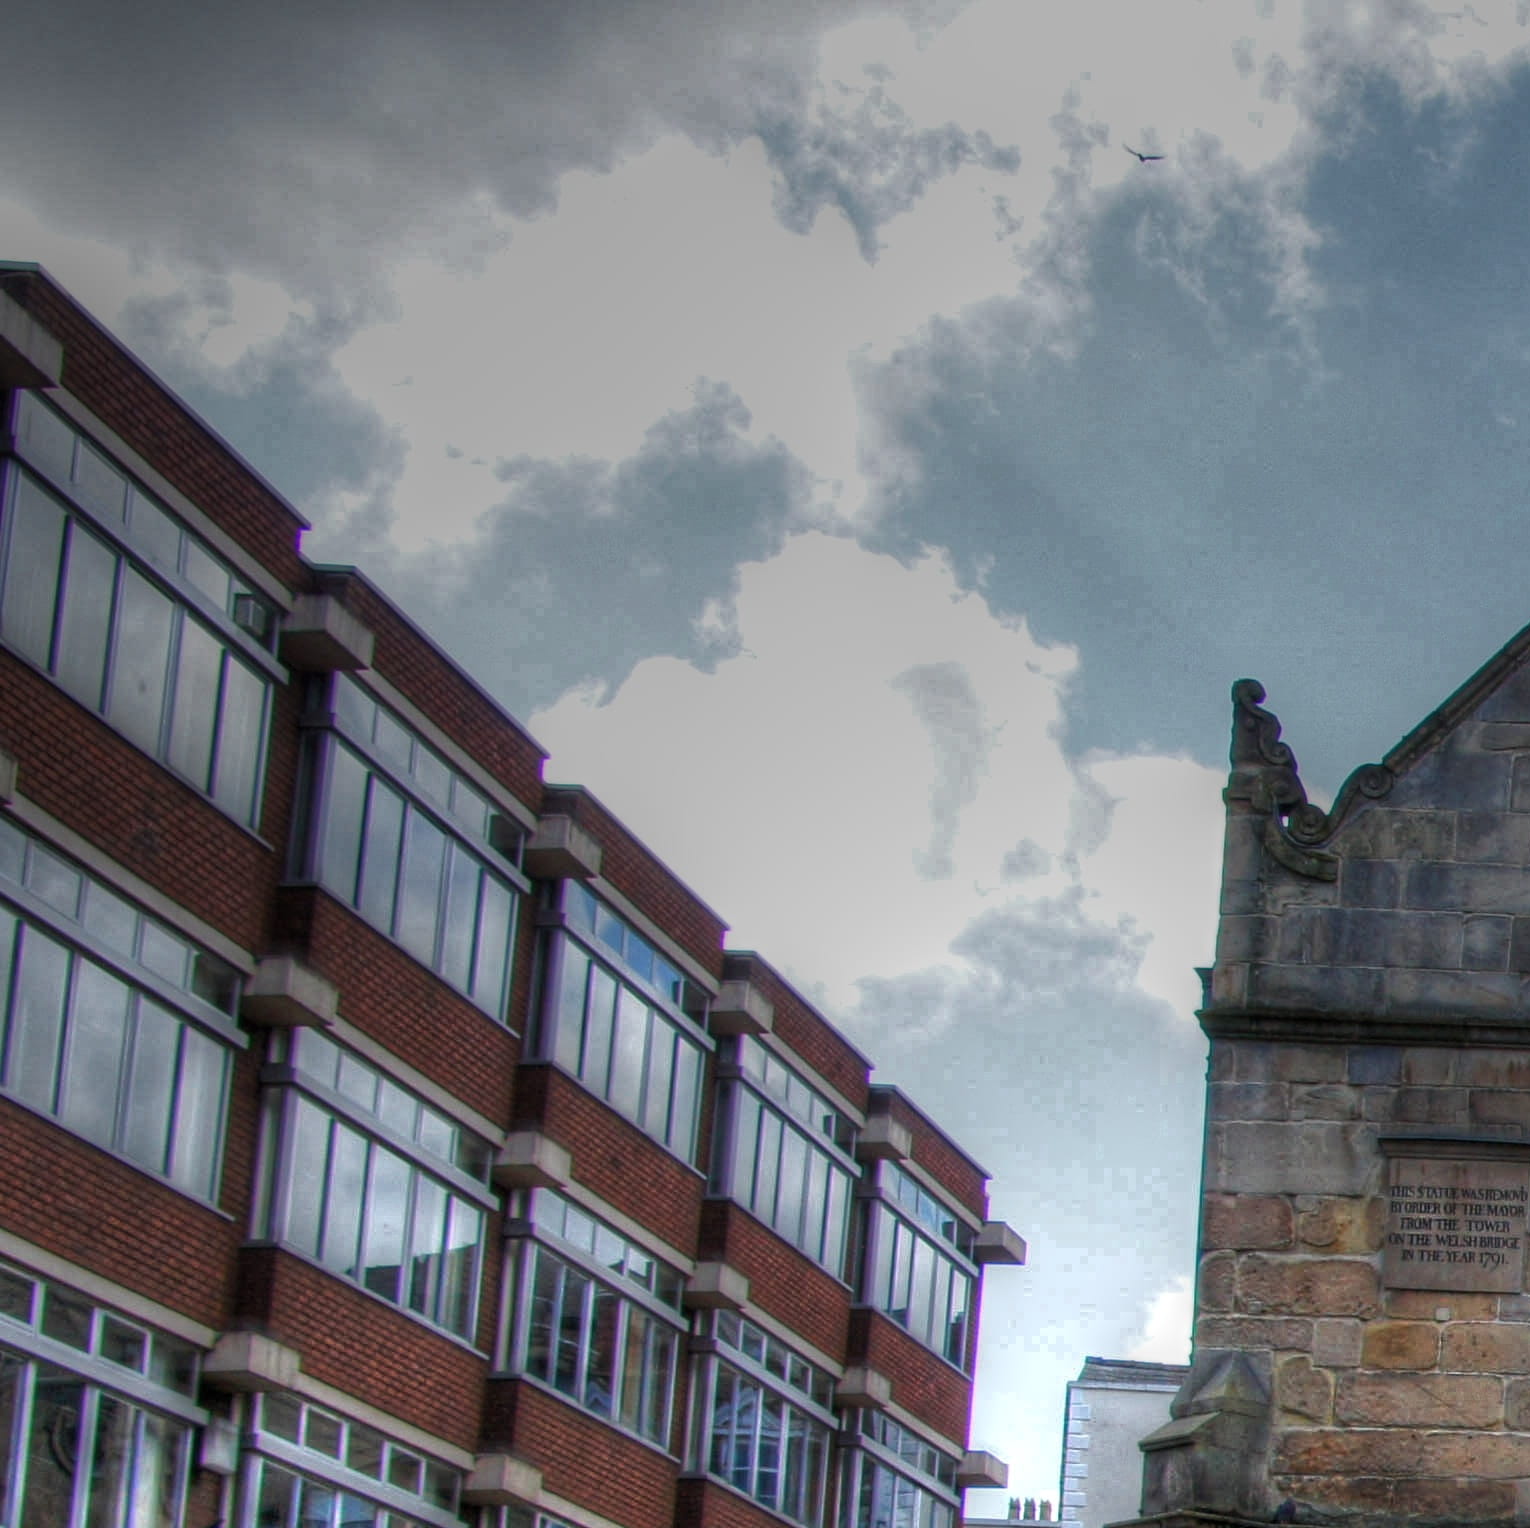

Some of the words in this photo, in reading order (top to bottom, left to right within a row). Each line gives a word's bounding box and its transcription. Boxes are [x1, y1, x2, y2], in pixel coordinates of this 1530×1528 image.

[1391, 1186, 1414, 1198] THIS
[1417, 1186, 1457, 1199] STATUE
[1461, 1188, 1484, 1200] WAS
[1405, 1201, 1440, 1214] ORDER
[1443, 1202, 1458, 1215] OF
[1462, 1203, 1485, 1216] THE
[1486, 1204, 1525, 1217] MAYOR
[1400, 1217, 1432, 1230] FROM
[1435, 1218, 1458, 1231] THE
[1467, 1220, 1510, 1232] TOWER
[1388, 1232, 1405, 1245] ON
[1407, 1234, 1433, 1246] THE
[1436, 1235, 1477, 1248] WELSH
[1479, 1236, 1520, 1250] BRIDGE
[1401, 1249, 1414, 1261] IN
[1445, 1250, 1475, 1263] YEAR
